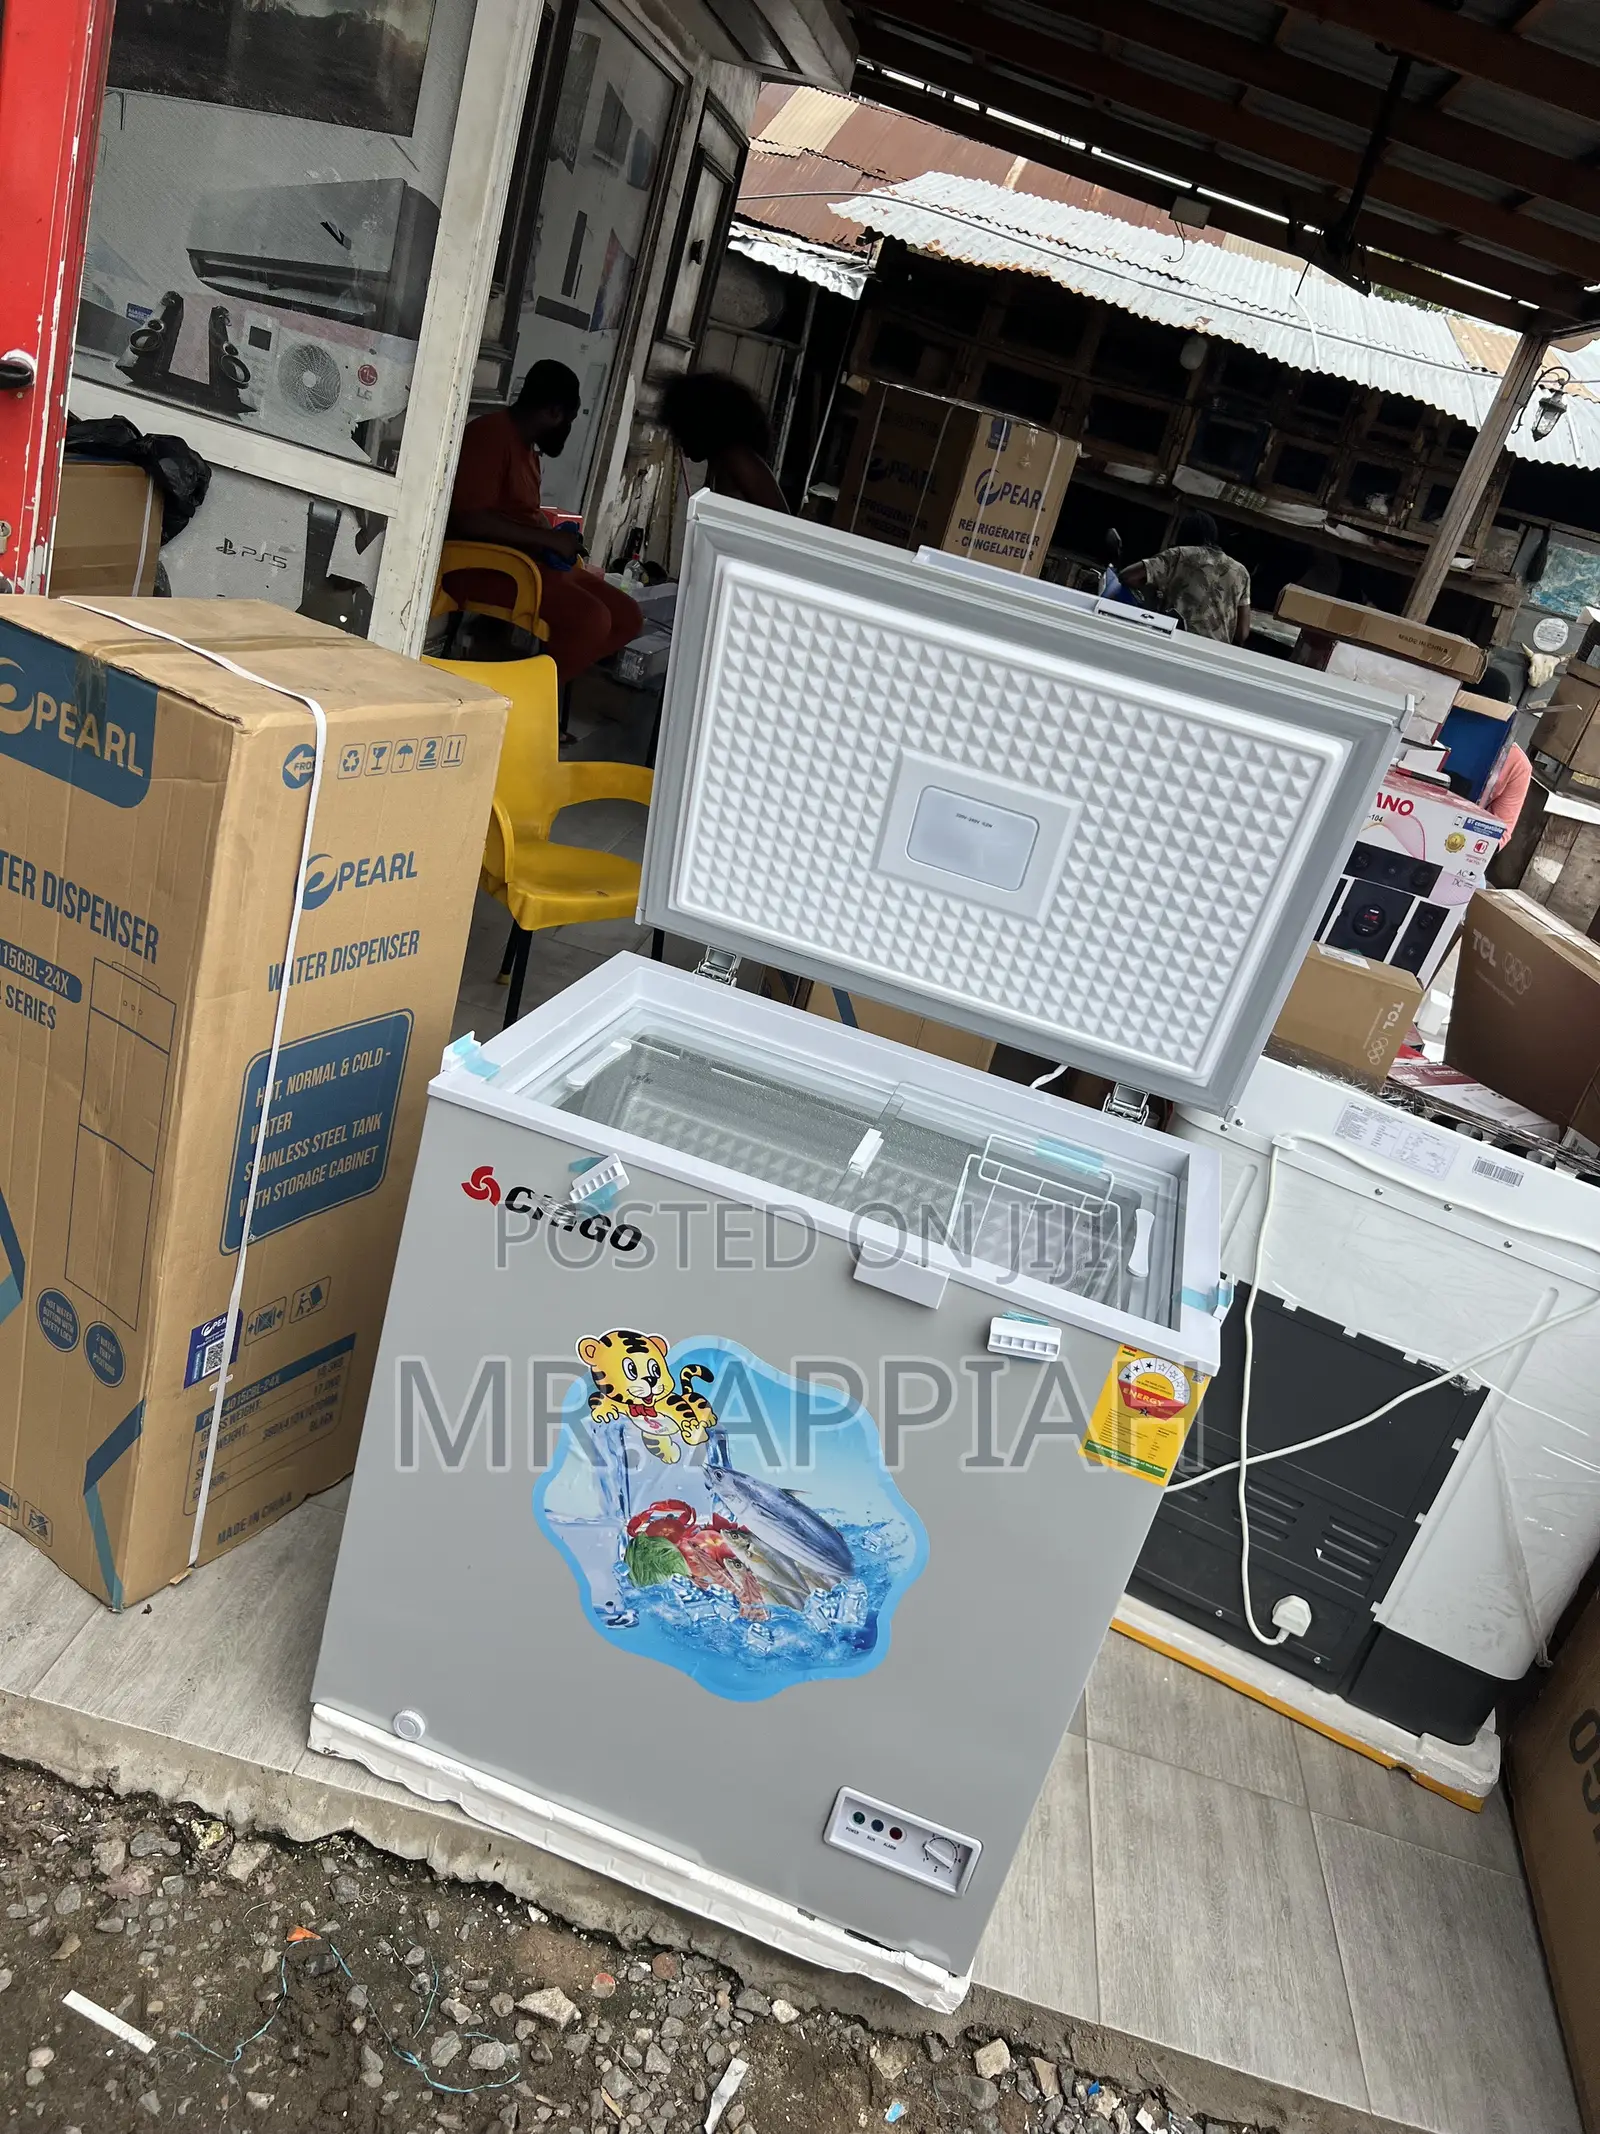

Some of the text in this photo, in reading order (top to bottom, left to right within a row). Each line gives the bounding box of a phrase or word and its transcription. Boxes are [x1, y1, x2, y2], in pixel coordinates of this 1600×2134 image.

[999, 481, 1046, 512] PEAR
[241, 545, 288, 569] PS5
[34, 691, 144, 778] PEARL
[336, 850, 419, 892] PEARL
[41, 869, 160, 964] DISPENSER
[330, 929, 420, 976] DISPENSER
[1472, 928, 1496, 968] TCL
[5, 984, 57, 1031] SERIES
[1382, 1001, 1404, 1030] TCL
[286, 1065, 337, 1096] NORMAL
[340, 1057, 349, 1078] &
[352, 1047, 384, 1074] COLD
[311, 1124, 348, 1152] STEEL
[352, 1112, 383, 1138] TANK
[273, 1164, 327, 1201] STORAGE
[328, 1145, 379, 1179] CABINET
[1122, 1387, 1165, 1407] ENERGY
[216, 1517, 248, 1546] MADE
[882, 1842, 897, 1851] ALARM
